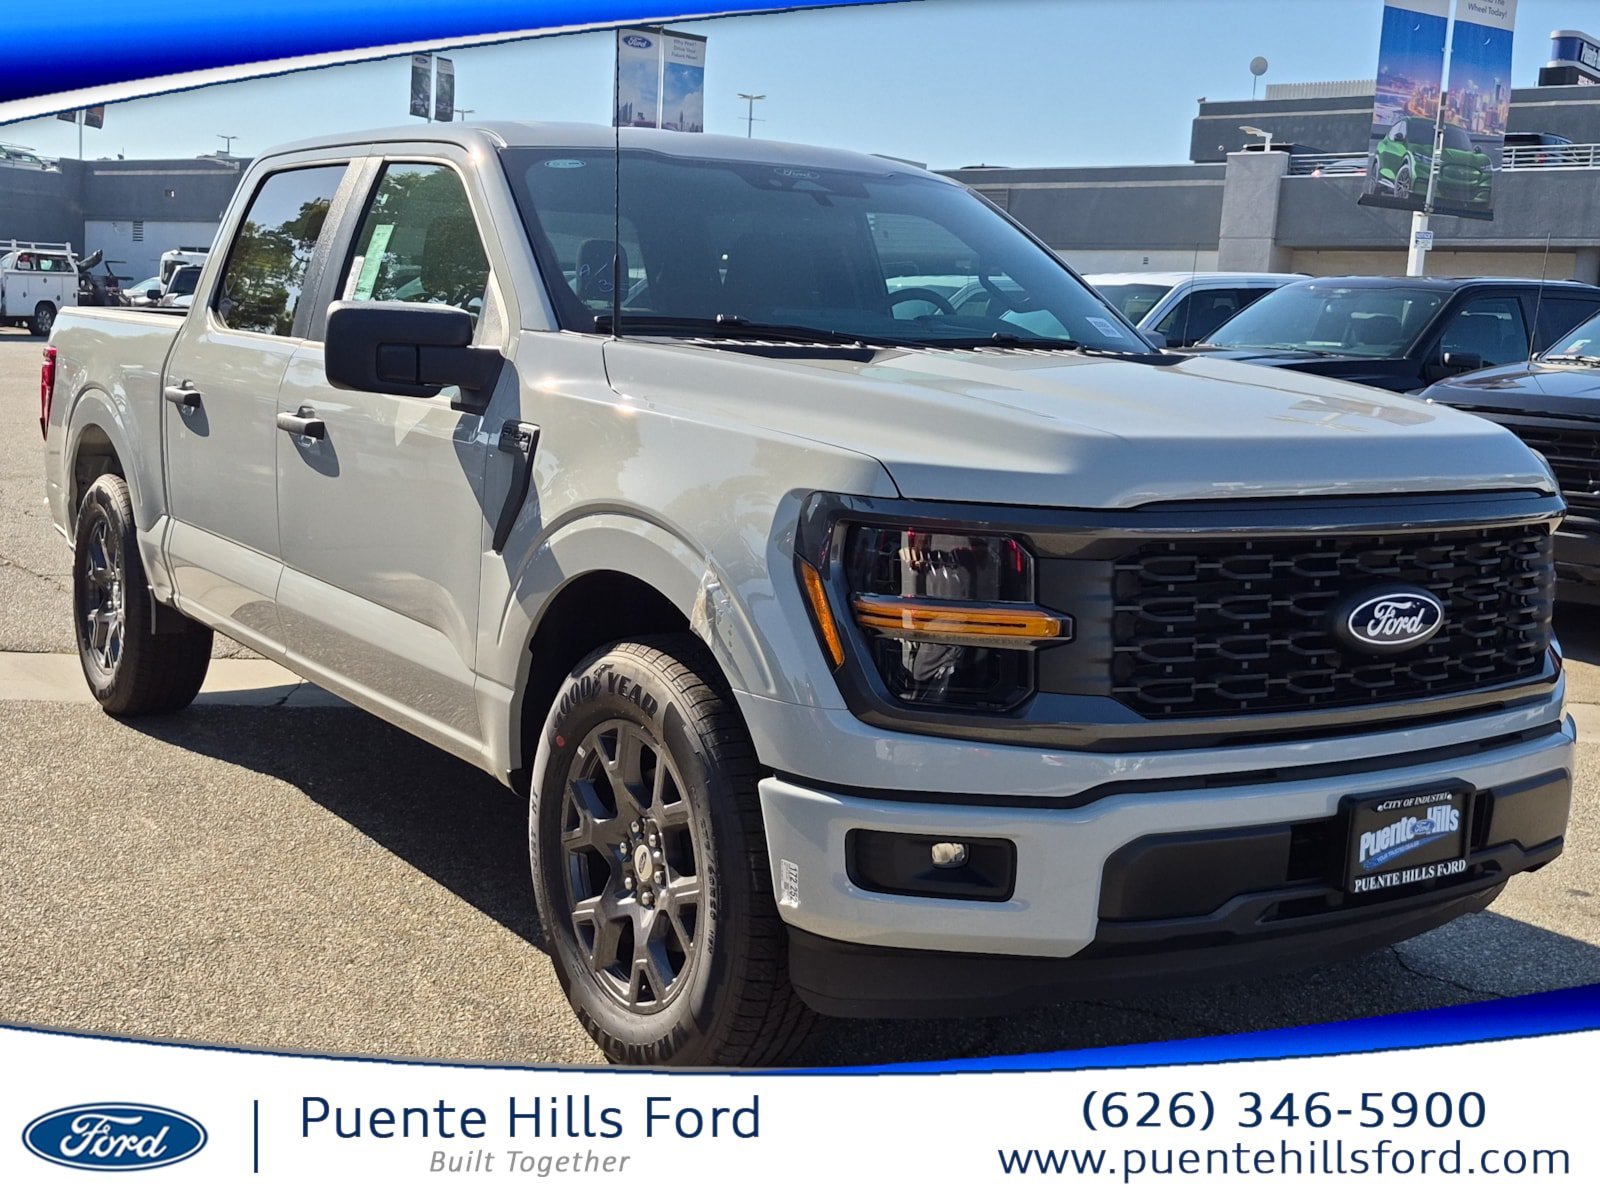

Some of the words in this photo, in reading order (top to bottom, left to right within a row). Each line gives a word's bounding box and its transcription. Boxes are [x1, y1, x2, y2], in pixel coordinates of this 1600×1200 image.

[1467, 2, 1487, 13] Wheel
[1488, 6, 1508, 20] Today!
[1367, 601, 1425, 636] Ford
[1383, 798, 1403, 810] CITY
[1403, 798, 1414, 807] OF
[1414, 792, 1448, 805] INDUSTRY
[1359, 816, 1417, 863] Puente
[1427, 804, 1460, 834] Hills
[1354, 873, 1400, 893] PUENTE
[1402, 864, 1435, 884] HILLS
[1437, 859, 1466, 877] FORD
